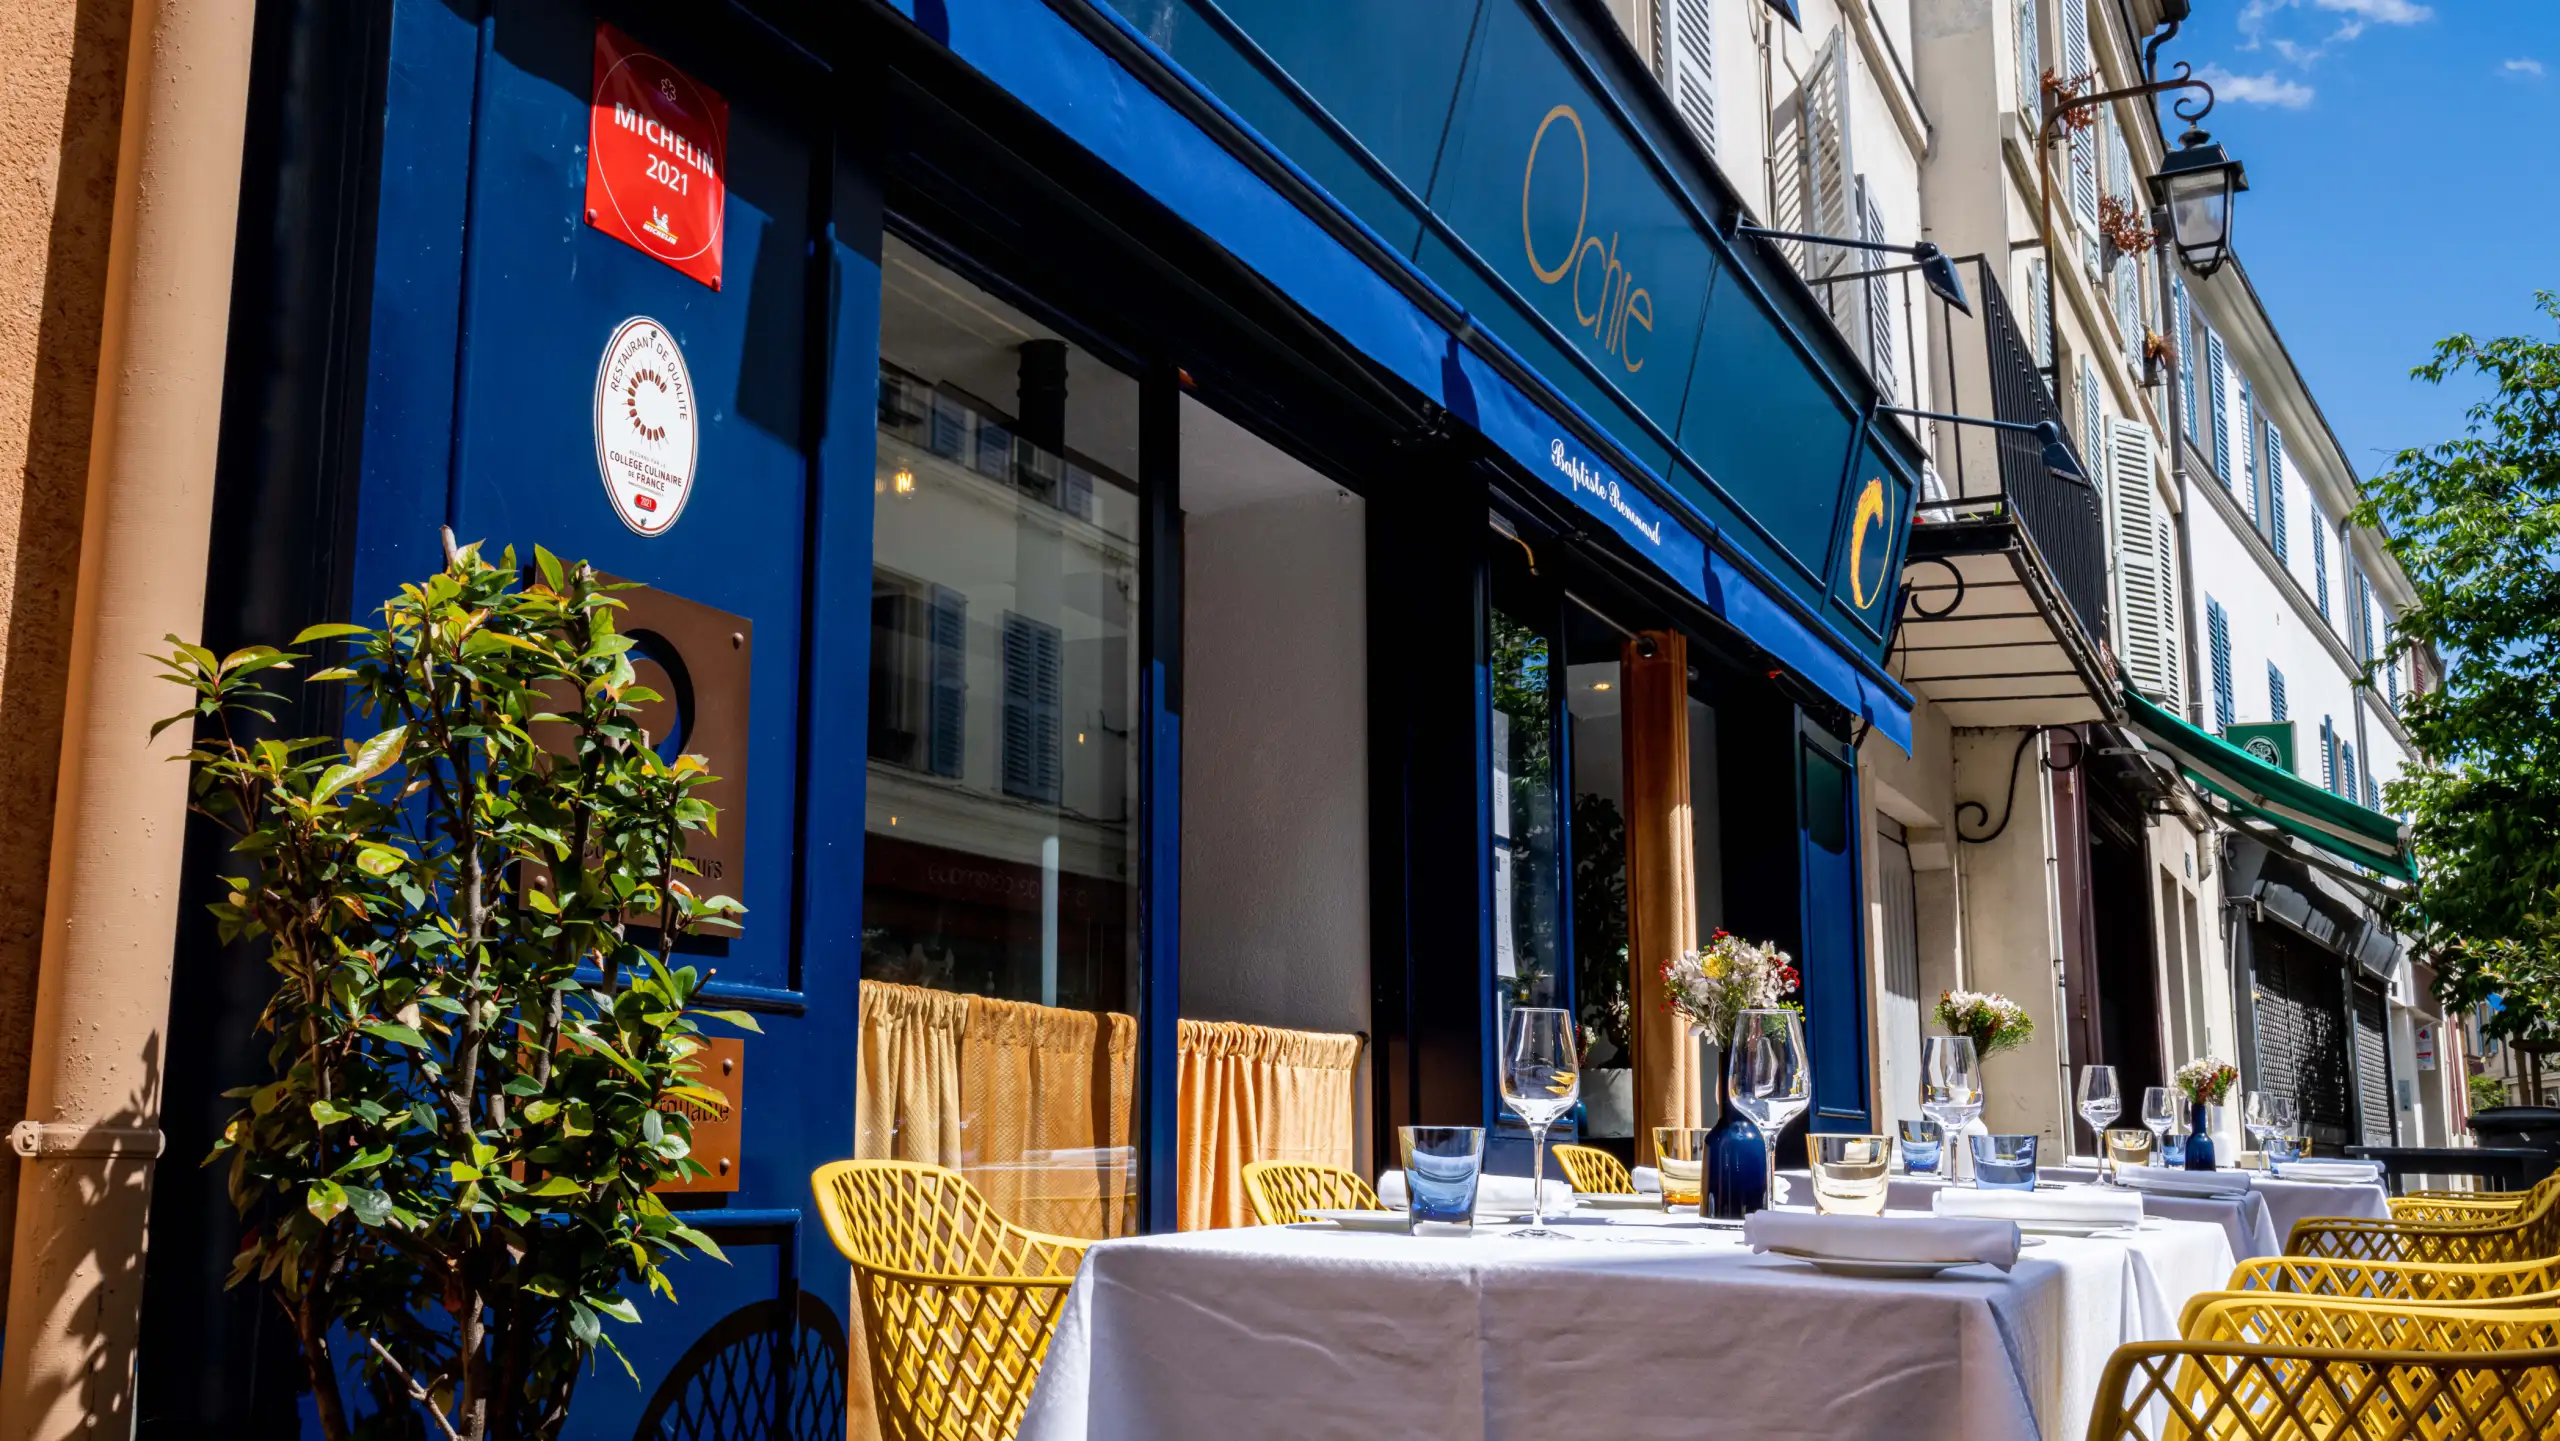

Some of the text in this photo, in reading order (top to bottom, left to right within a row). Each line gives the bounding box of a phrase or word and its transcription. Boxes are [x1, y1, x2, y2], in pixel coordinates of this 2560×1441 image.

[614, 101, 715, 180] MICHELIN
[645, 152, 688, 197] 2021
[642, 221, 678, 245] MICHELIN
[610, 336, 655, 392] RESTAURANT
[656, 343, 669, 361] DE
[609, 450, 683, 488] COLLEGE CULINAIRE
[628, 470, 635, 479] DE
[636, 472, 665, 493] FRANCE
[1551, 438, 1607, 500] Baptiste
